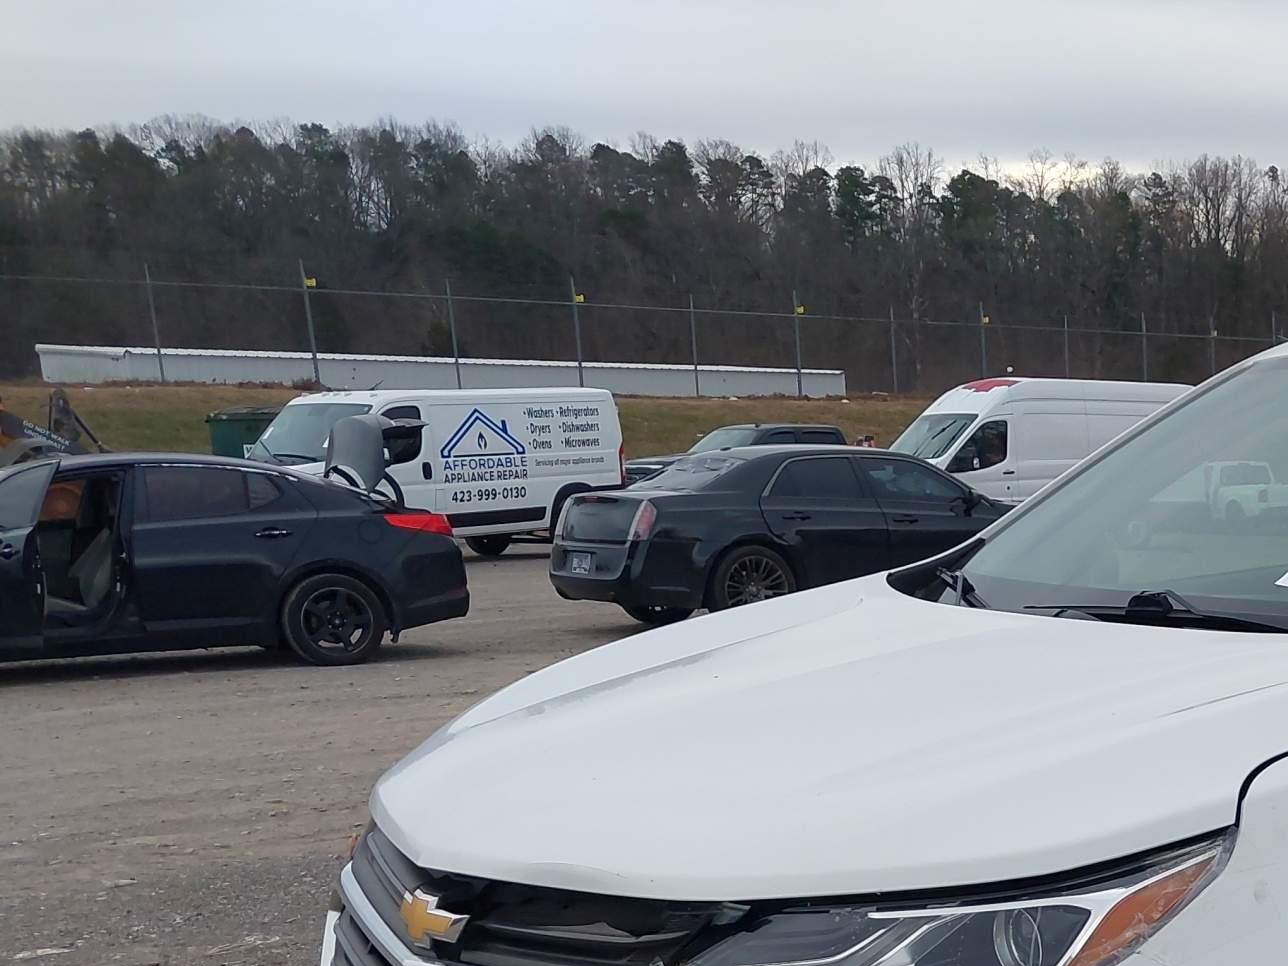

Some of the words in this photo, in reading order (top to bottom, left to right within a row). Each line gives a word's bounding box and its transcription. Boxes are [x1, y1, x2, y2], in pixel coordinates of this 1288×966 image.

[526, 407, 554, 419] Washers
[559, 406, 599, 419] Refrigerators
[530, 422, 551, 436] Dryers
[562, 421, 600, 433] Dishwashers
[532, 438, 552, 450] Ovens
[564, 436, 600, 449] Microwaves
[443, 456, 528, 472] AFFORDABLE
[444, 470, 496, 484] APPLIANCE
[497, 468, 528, 481] REPAIR
[452, 486, 527, 504] 423-999-0130
